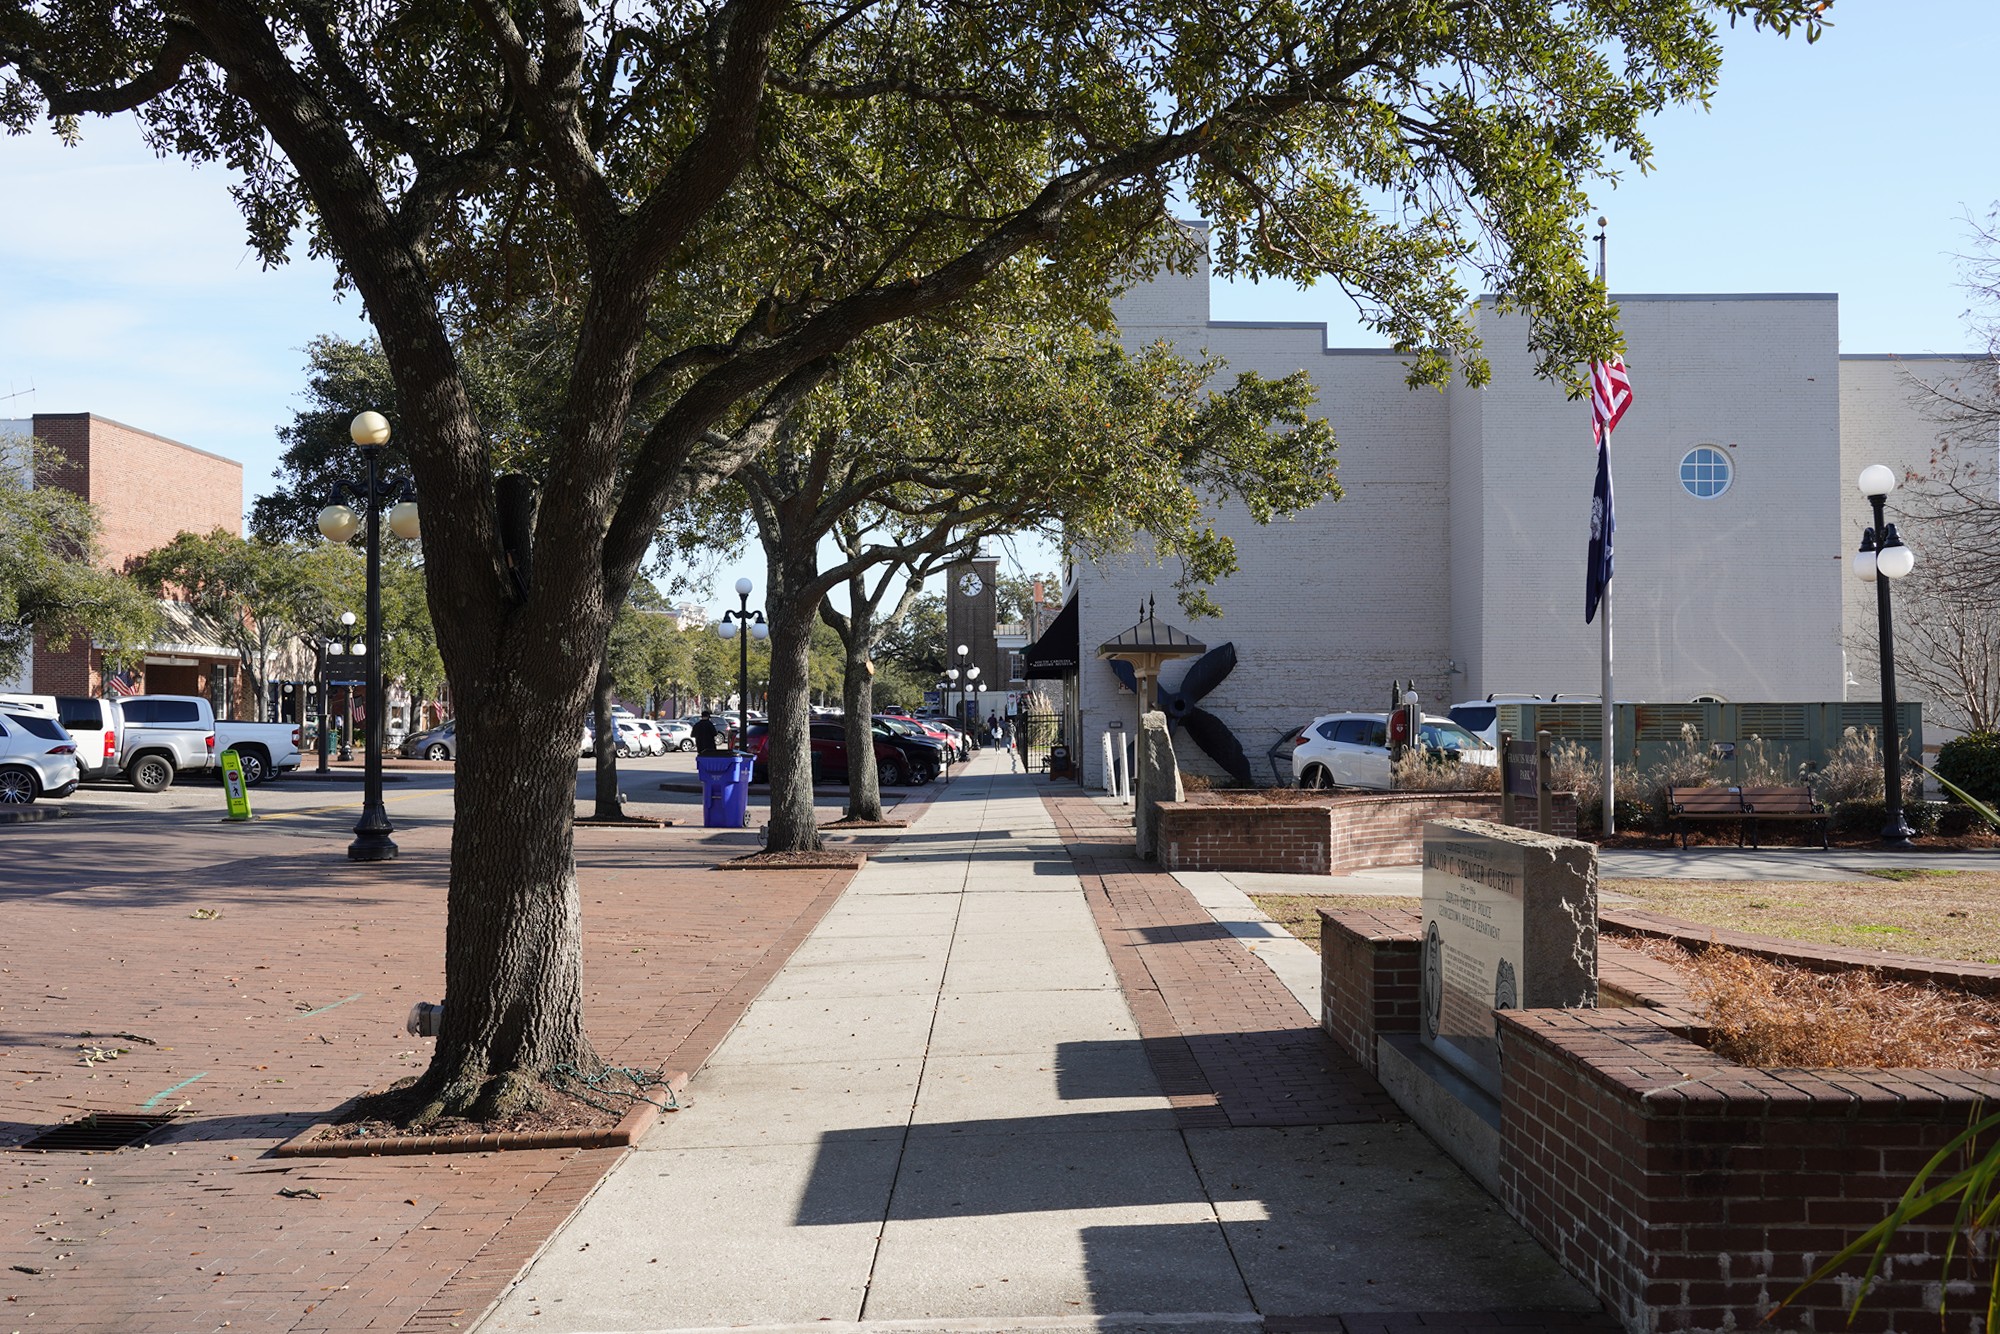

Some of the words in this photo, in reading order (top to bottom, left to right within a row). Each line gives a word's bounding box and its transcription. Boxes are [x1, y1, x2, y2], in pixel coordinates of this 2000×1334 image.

[1508, 753, 1525, 763] FRANCIS
[1519, 769, 1531, 780] PARK
[1429, 851, 1447, 872] MAJOR
[1457, 859, 1485, 885] SPENCER
[1488, 868, 1515, 894] GUERRY
[1477, 903, 1491, 919] POLICE
[1462, 914, 1475, 930] POLICE
[1475, 919, 1500, 941] DEPARTMENT
